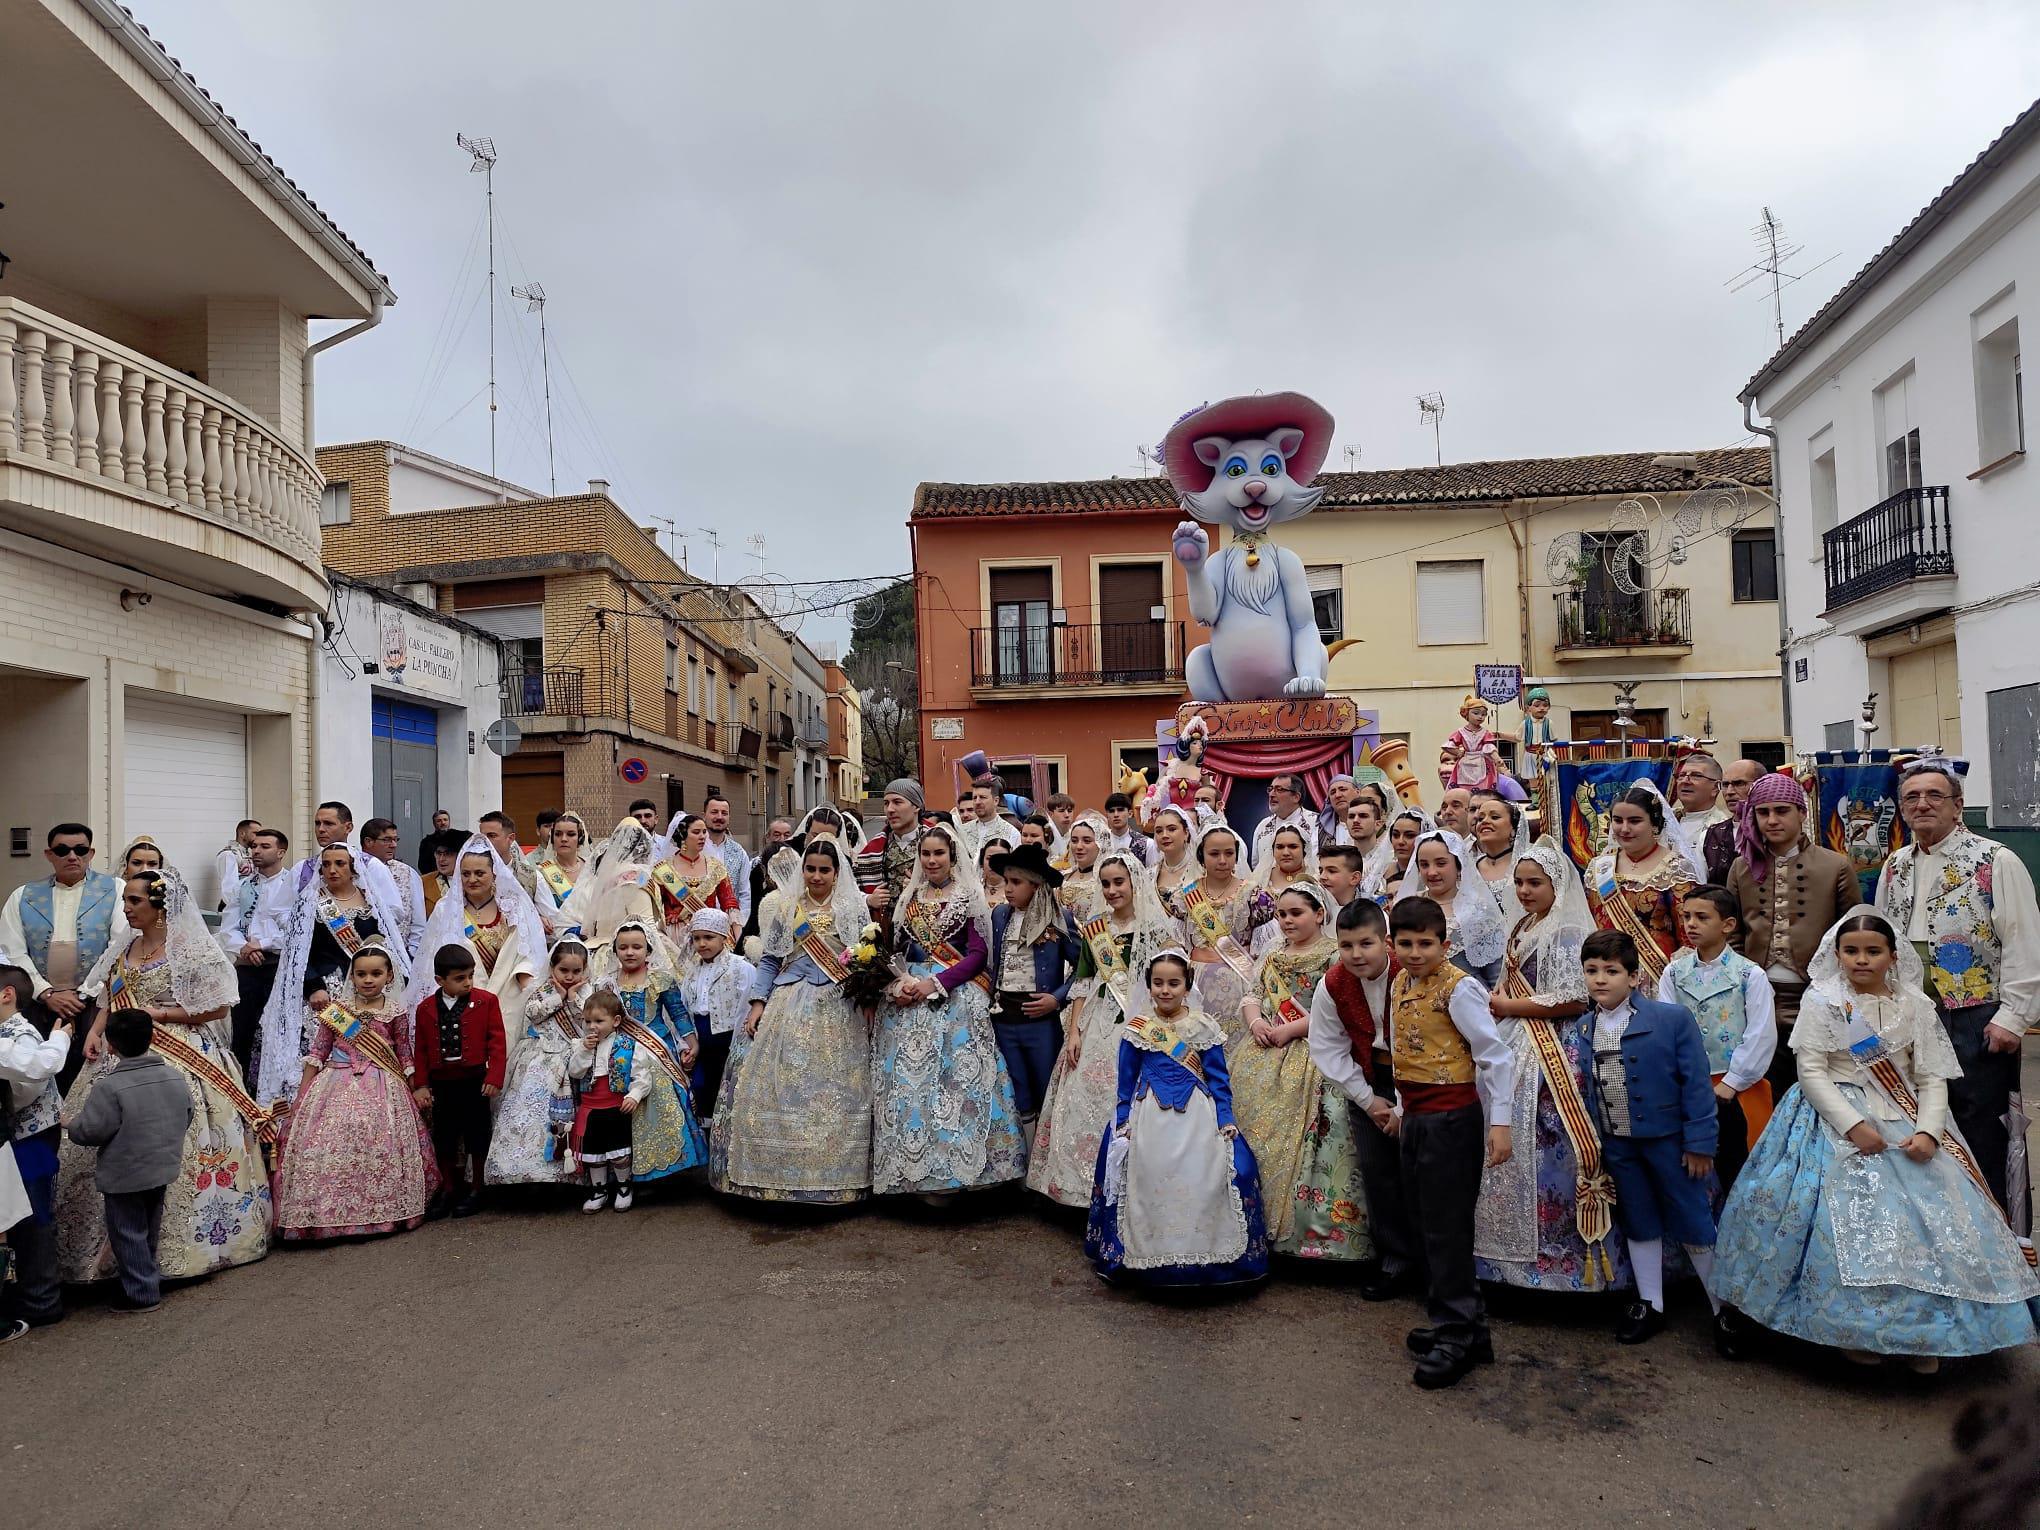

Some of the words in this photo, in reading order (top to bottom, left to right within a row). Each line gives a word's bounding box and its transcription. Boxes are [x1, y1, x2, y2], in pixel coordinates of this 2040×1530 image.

[409, 637, 428, 652] CASAL
[430, 644, 454, 662] FALLERO
[412, 656, 422, 672] LA
[423, 660, 452, 680] PUNCHA
[1482, 669, 1514, 678] FALLA
[1492, 679, 1507, 687] LA
[1276, 701, 1350, 732] Club
